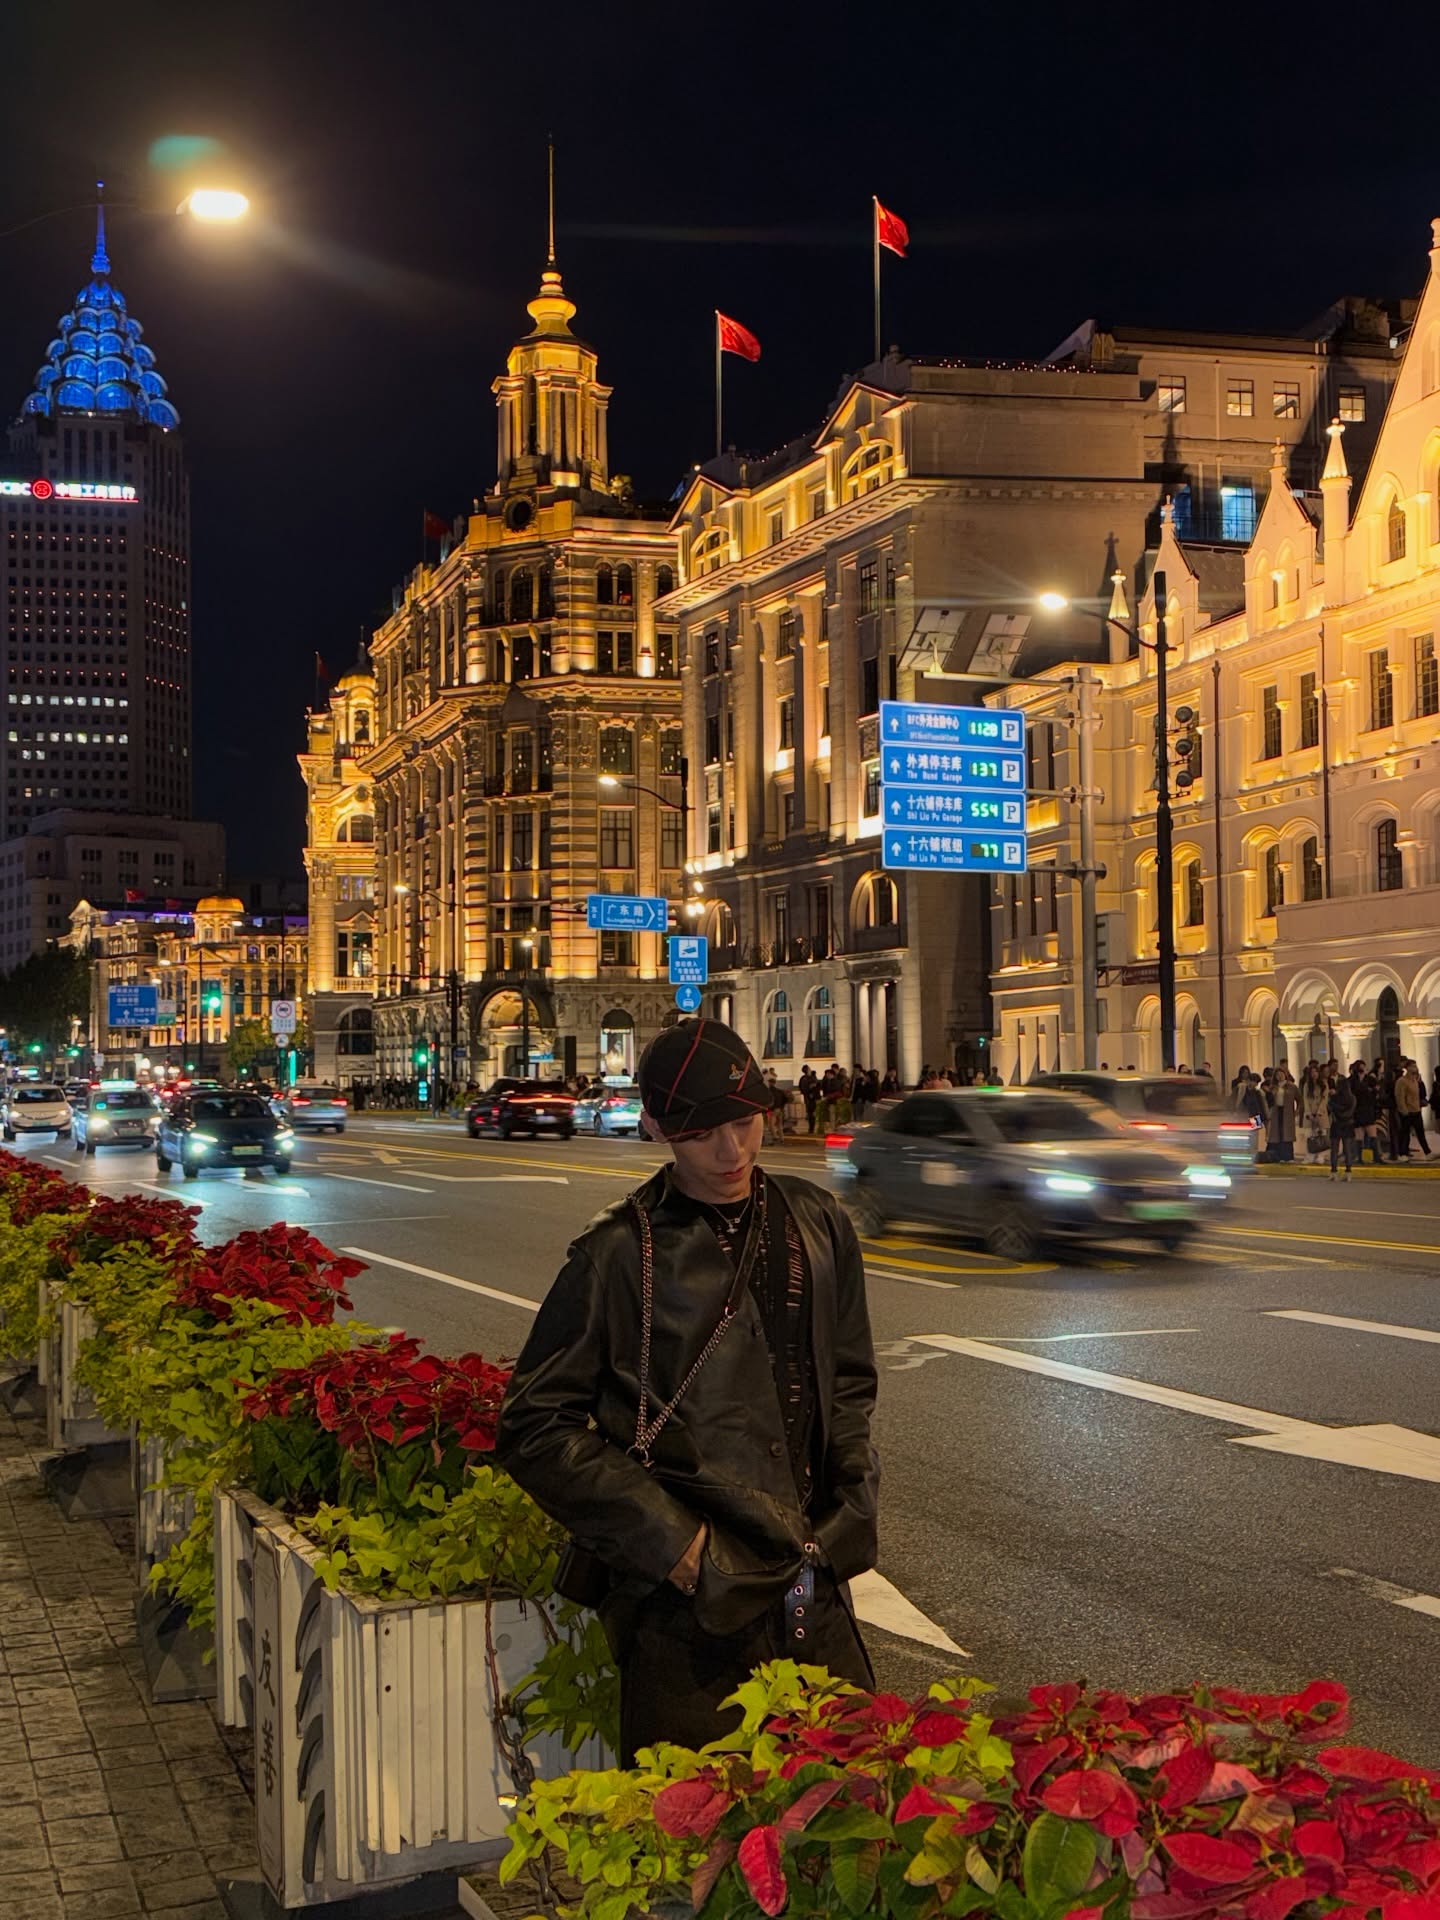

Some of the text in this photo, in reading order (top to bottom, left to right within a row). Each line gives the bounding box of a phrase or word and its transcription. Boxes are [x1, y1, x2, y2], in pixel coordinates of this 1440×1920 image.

[1005, 723, 1015, 738] P
[906, 753, 962, 772] 外滩停车库
[971, 762, 1016, 778] 137 P
[907, 770, 918, 780] The
[907, 794, 963, 812] 十六铺停车库
[971, 802, 1017, 820] 554 P
[980, 843, 1017, 861] 77 P
[607, 903, 644, 917] 广东路
[258, 1628, 277, 1797] 友善
